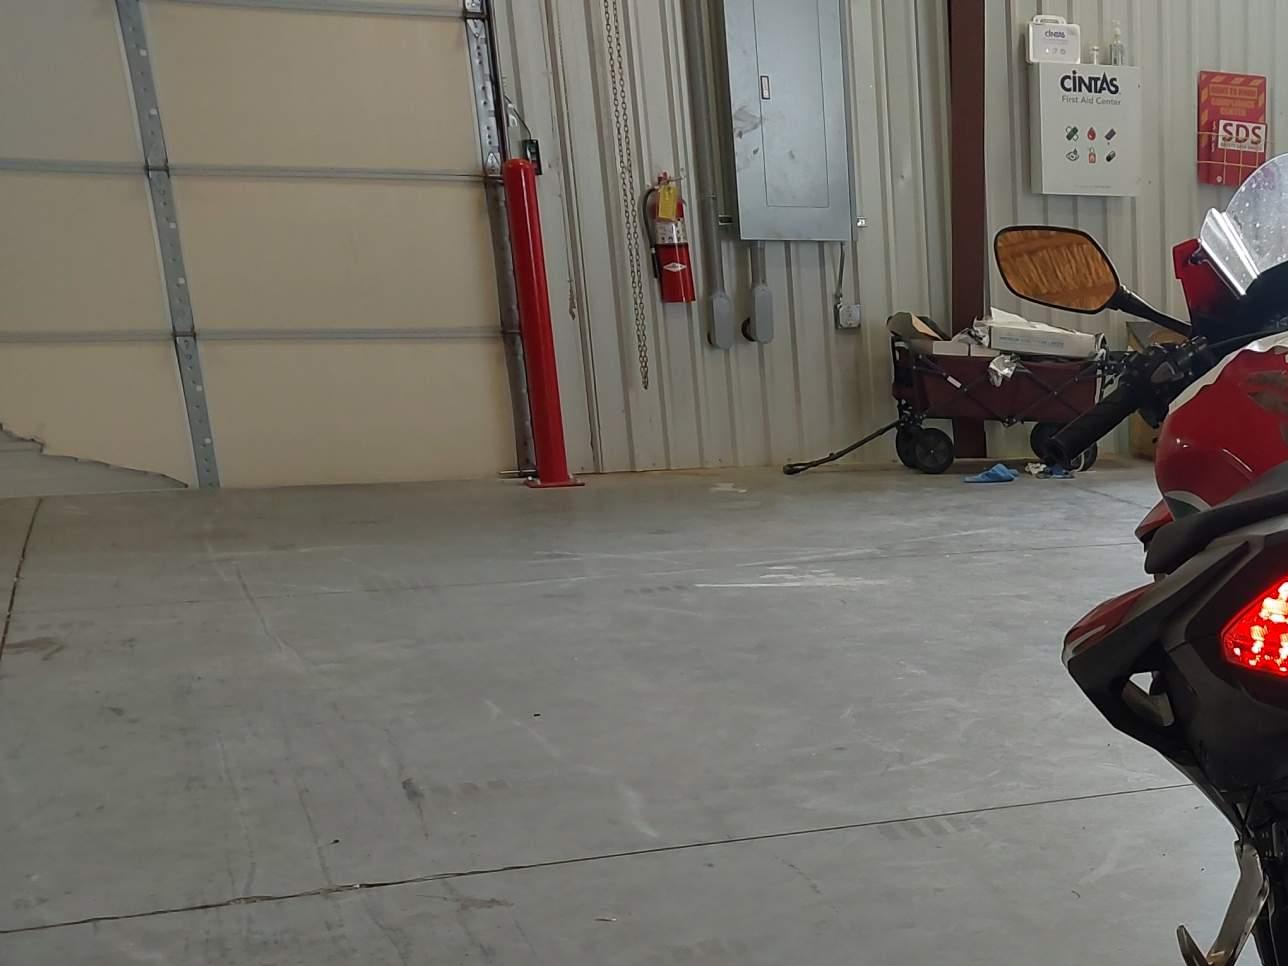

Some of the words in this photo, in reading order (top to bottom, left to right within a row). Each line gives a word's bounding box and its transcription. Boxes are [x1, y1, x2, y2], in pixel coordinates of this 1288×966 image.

[1060, 69, 1120, 95] CINTAS
[1061, 95, 1079, 104] First
[1080, 95, 1094, 105] Aid
[1095, 96, 1121, 106] Center
[1222, 122, 1262, 145] SDS
